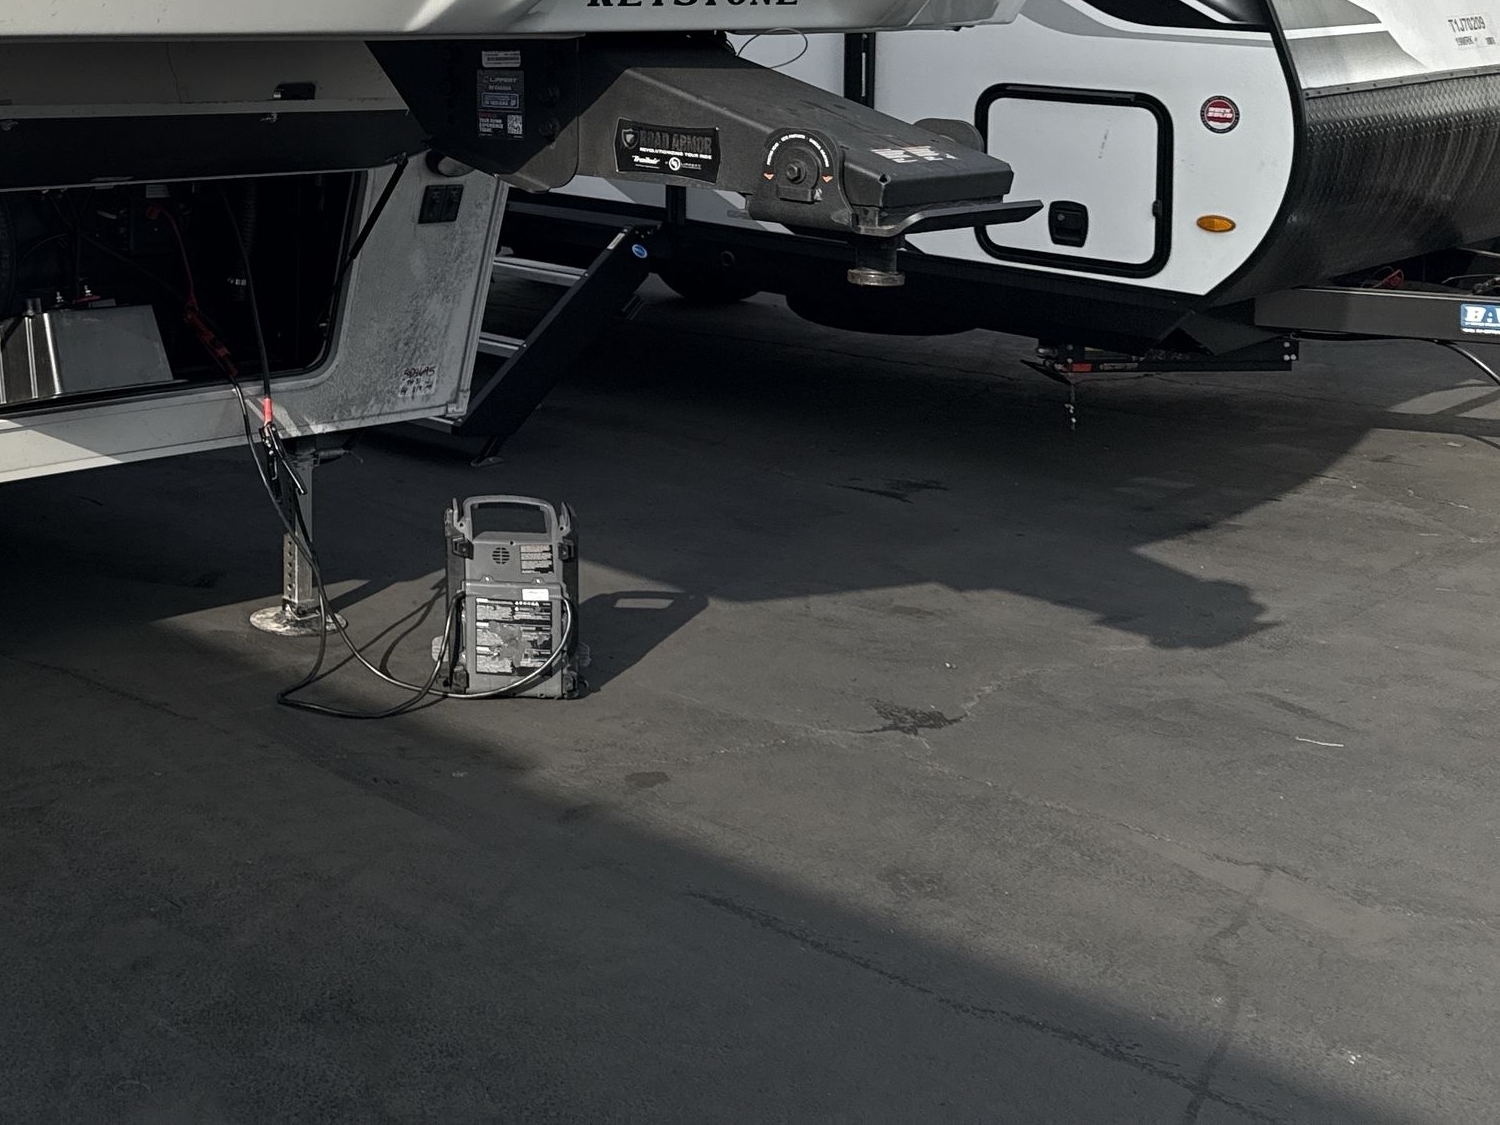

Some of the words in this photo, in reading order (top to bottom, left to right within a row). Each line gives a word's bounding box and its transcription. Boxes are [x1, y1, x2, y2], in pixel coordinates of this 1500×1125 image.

[1447, 15, 1486, 33] T1J70209
[671, 134, 713, 155] ARMOR
[1463, 305, 1500, 323] BA
